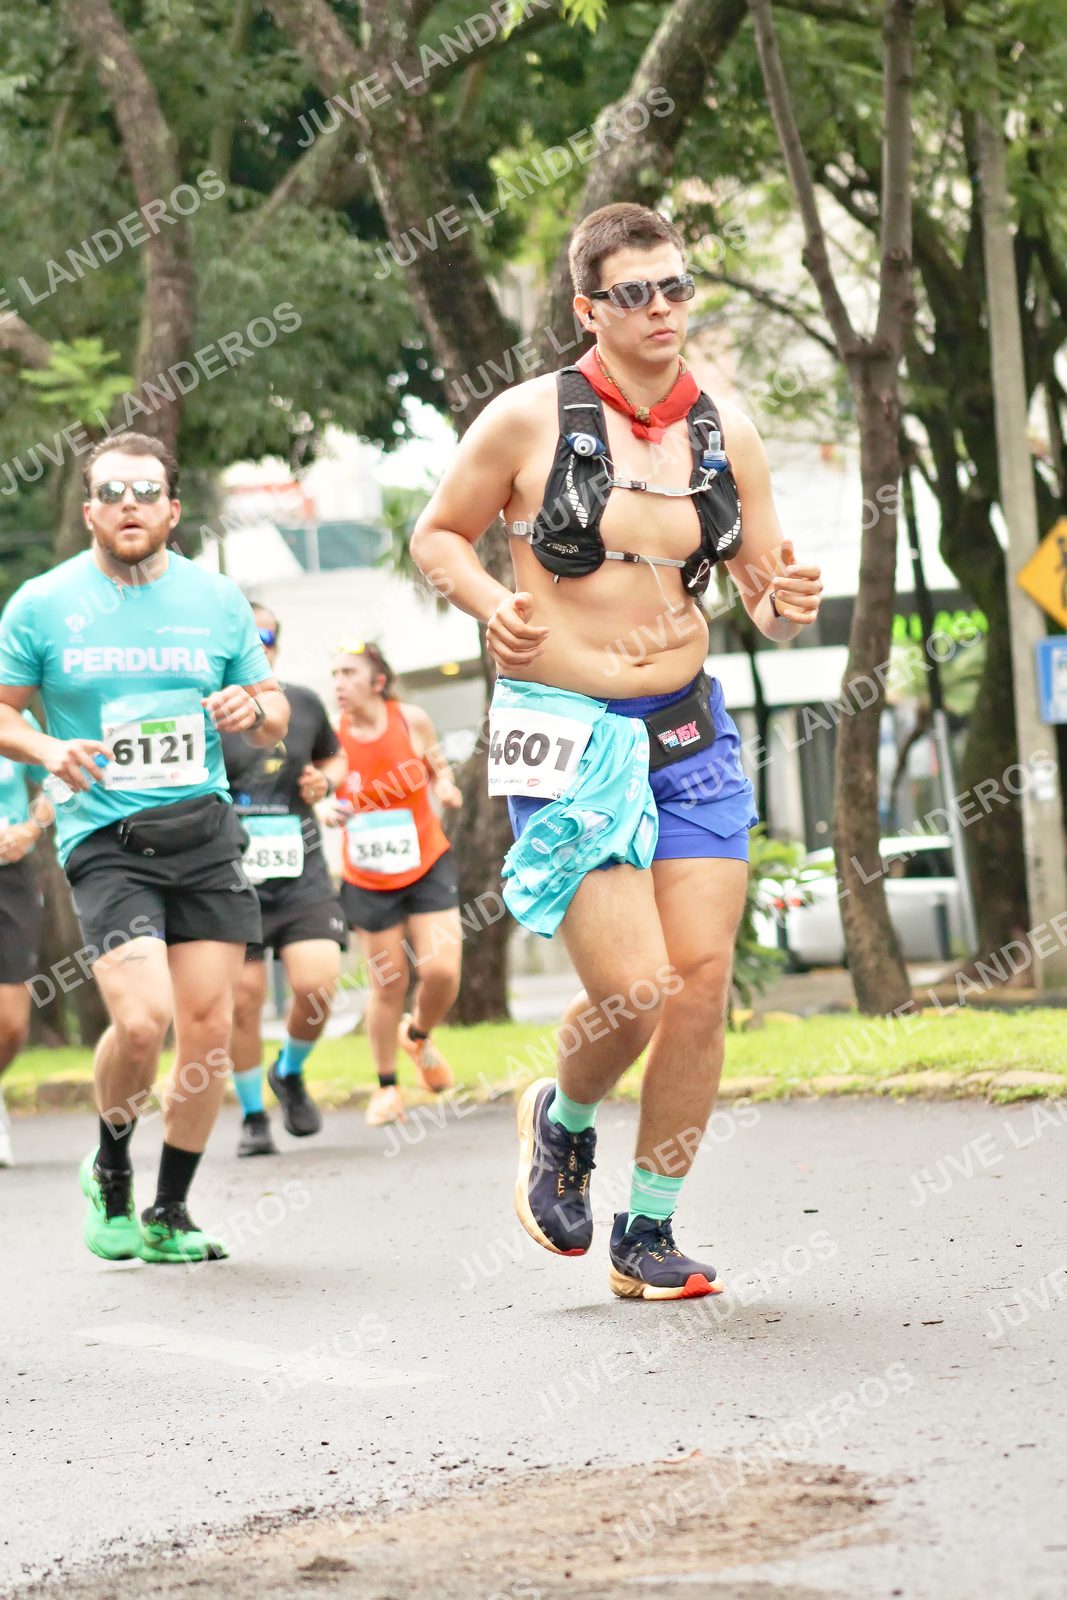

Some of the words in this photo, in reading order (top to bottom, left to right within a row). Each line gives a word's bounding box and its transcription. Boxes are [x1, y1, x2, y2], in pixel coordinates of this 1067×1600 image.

[63, 648, 211, 674] PERDURA
[112, 733, 194, 766] 6121
[489, 729, 575, 772] 4601
[356, 838, 411, 860] 3842
